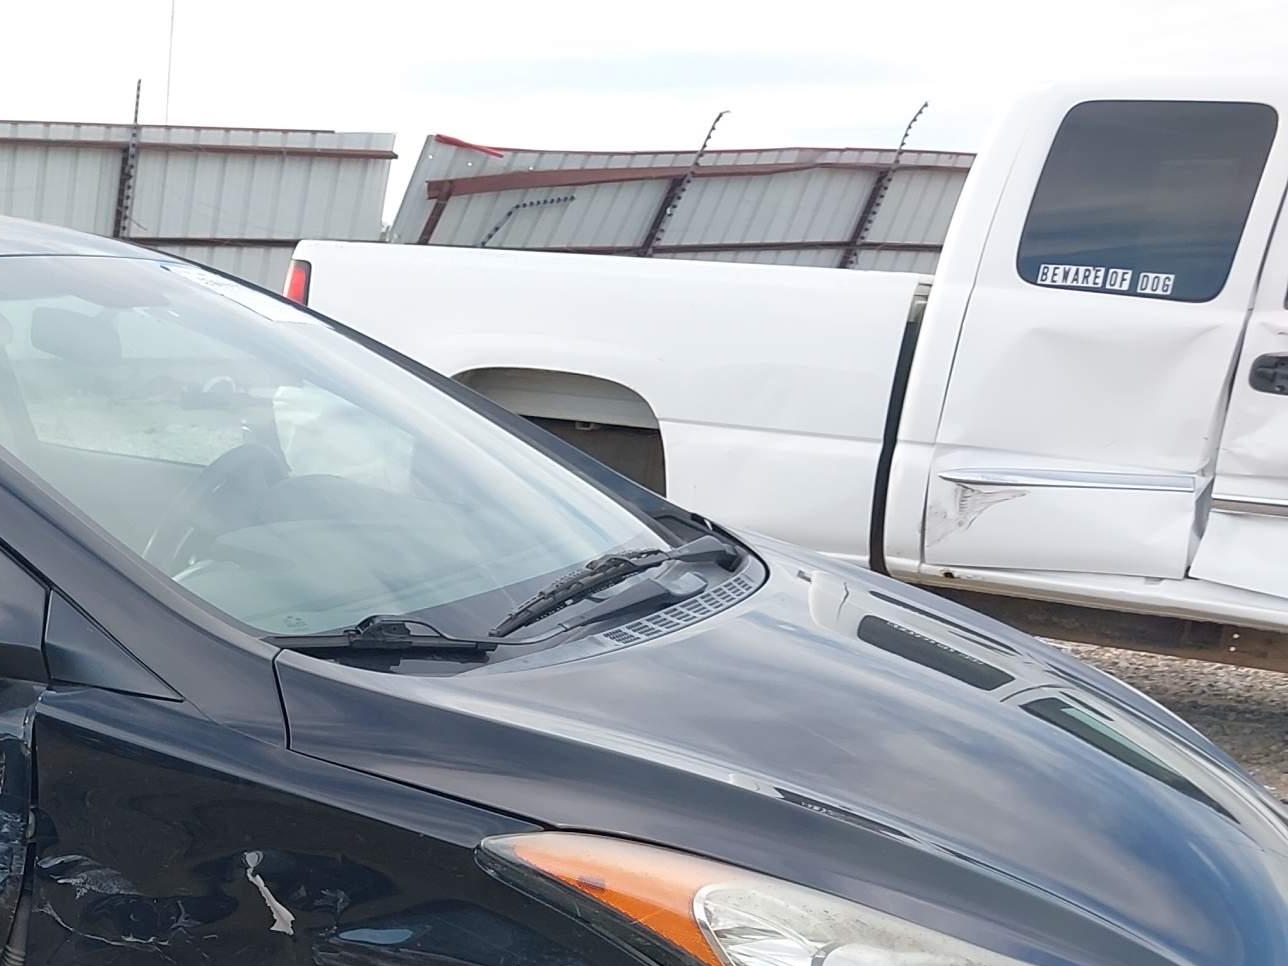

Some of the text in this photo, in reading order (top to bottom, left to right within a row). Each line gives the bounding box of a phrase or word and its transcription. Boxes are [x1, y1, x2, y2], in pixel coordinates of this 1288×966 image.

[1039, 265, 1172, 293] BEWARE OF DOG
